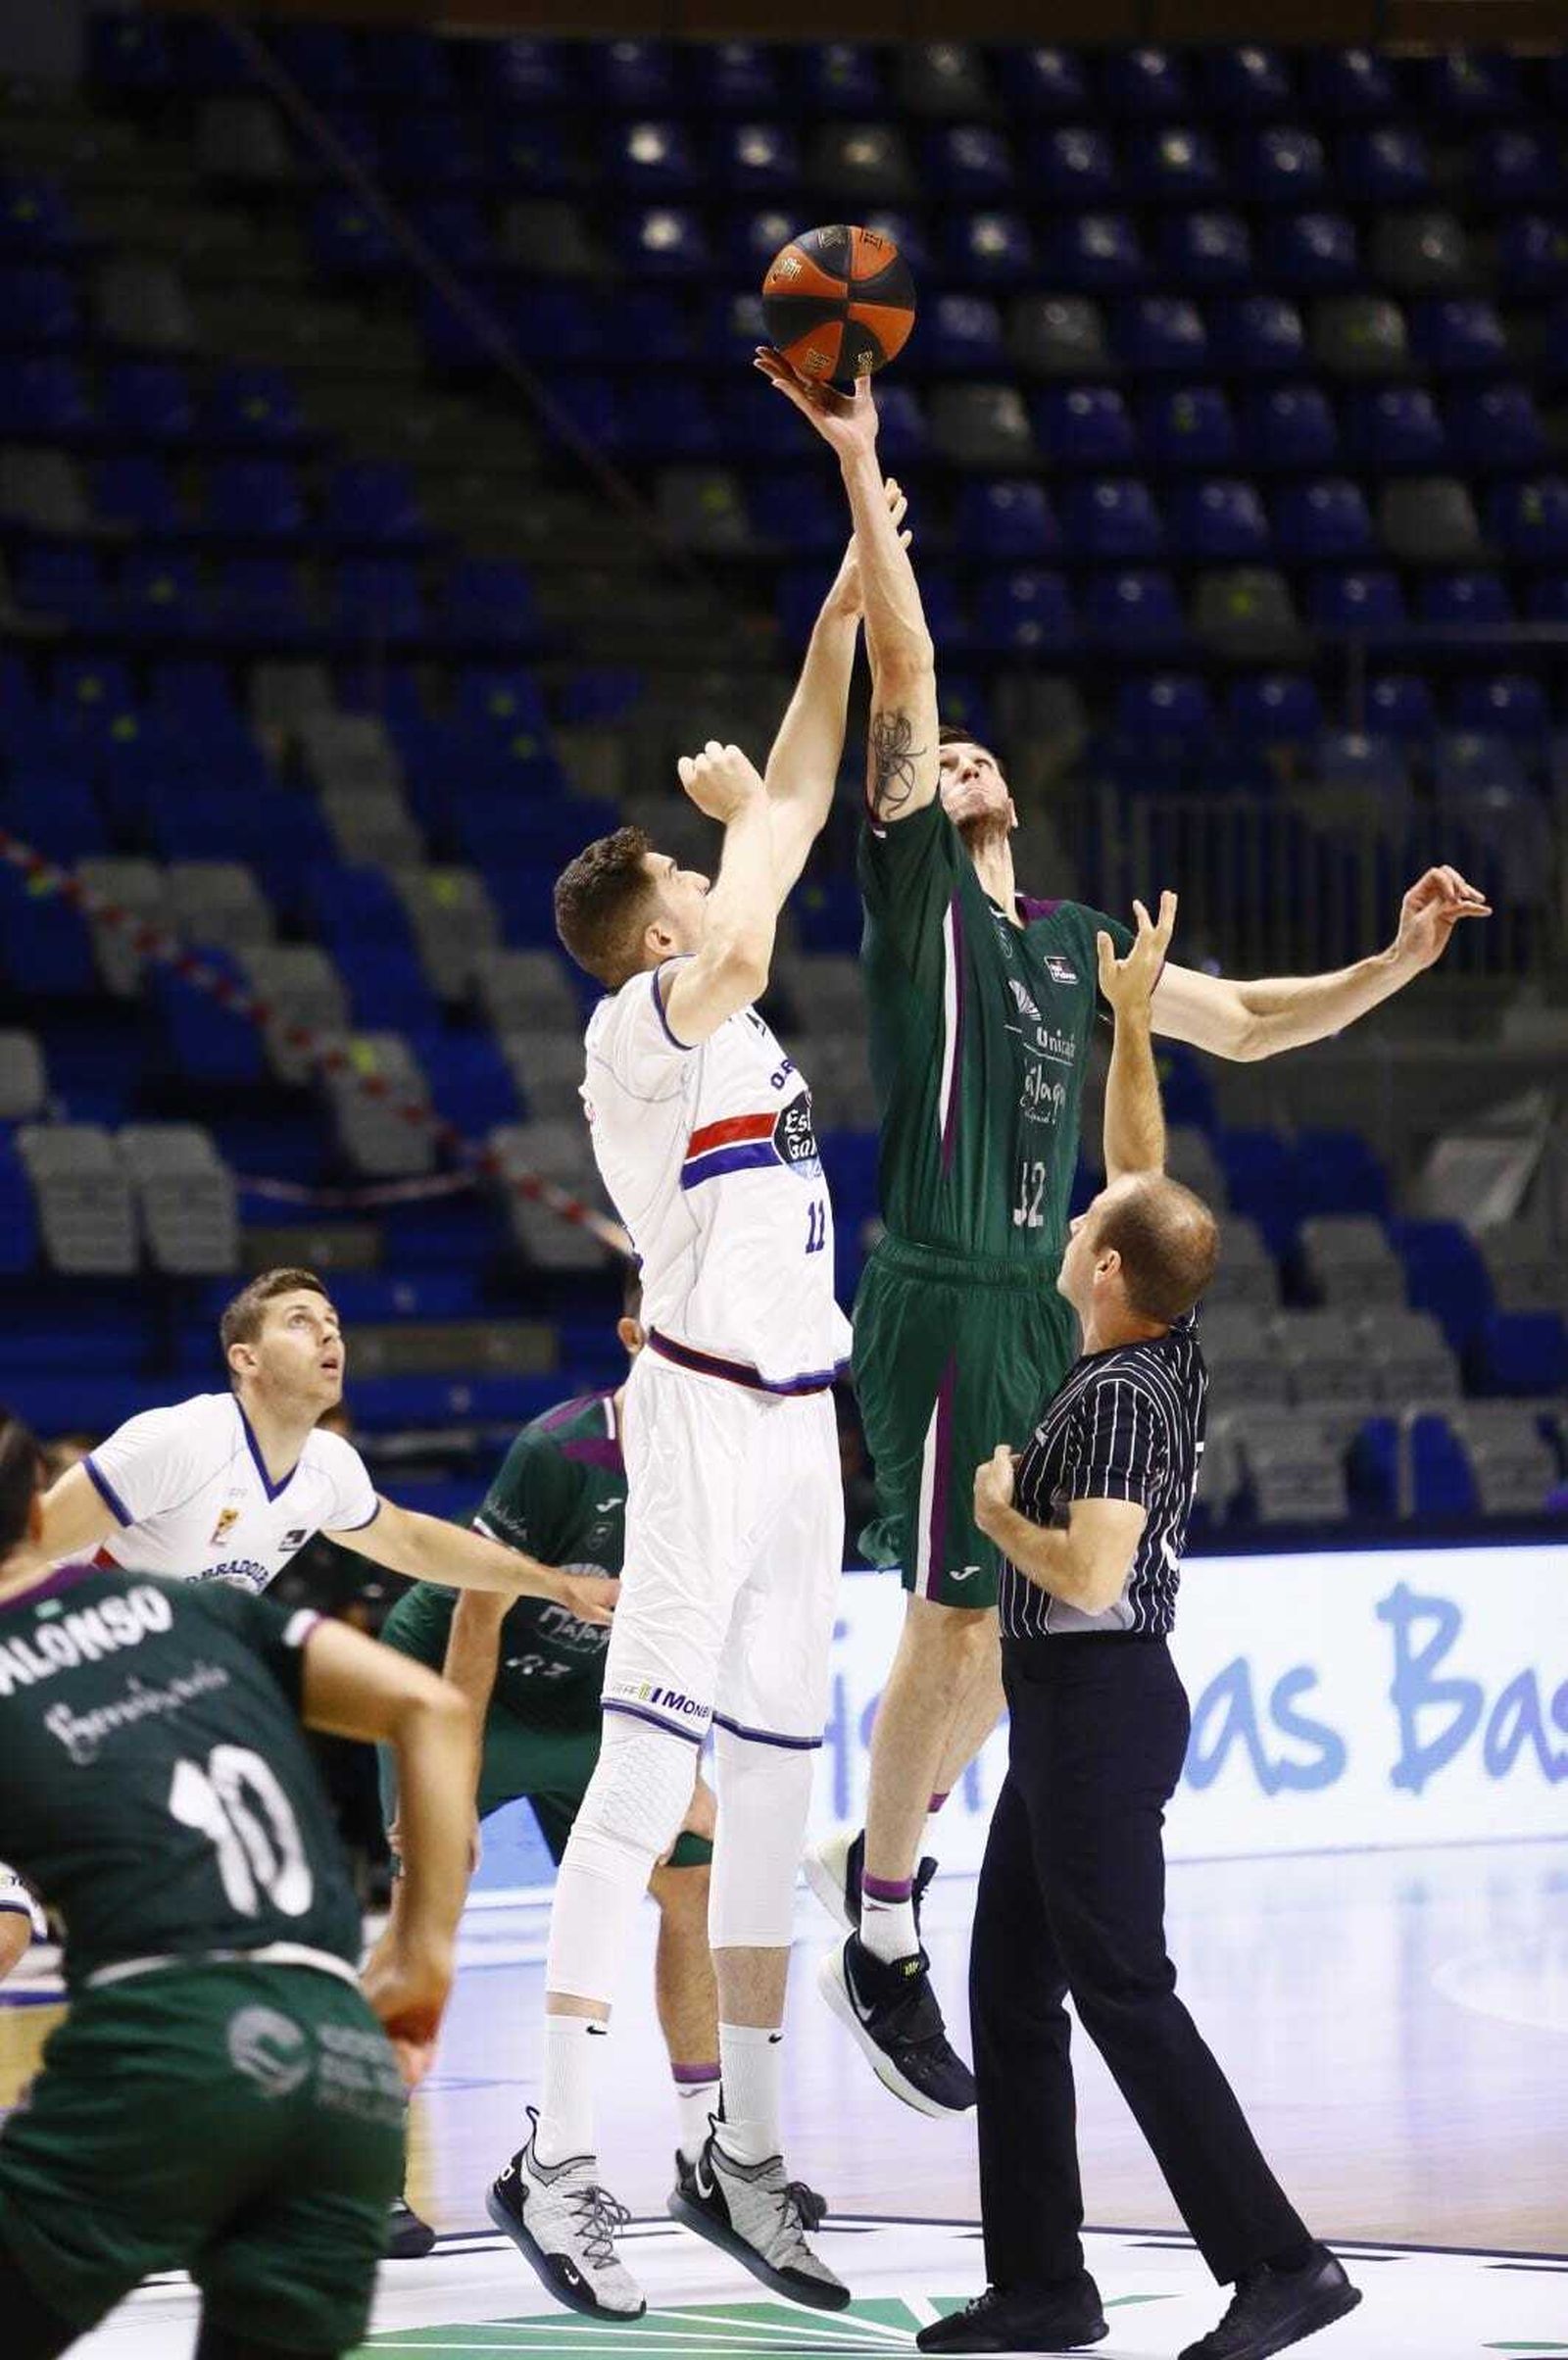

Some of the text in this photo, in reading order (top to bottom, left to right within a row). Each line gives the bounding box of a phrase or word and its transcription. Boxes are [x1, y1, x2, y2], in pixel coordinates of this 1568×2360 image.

[805, 1199, 825, 1254] 11
[1013, 1161, 1046, 1228] 12
[0, 1585, 173, 1696] ALONSO
[168, 1743, 313, 1917] 10
